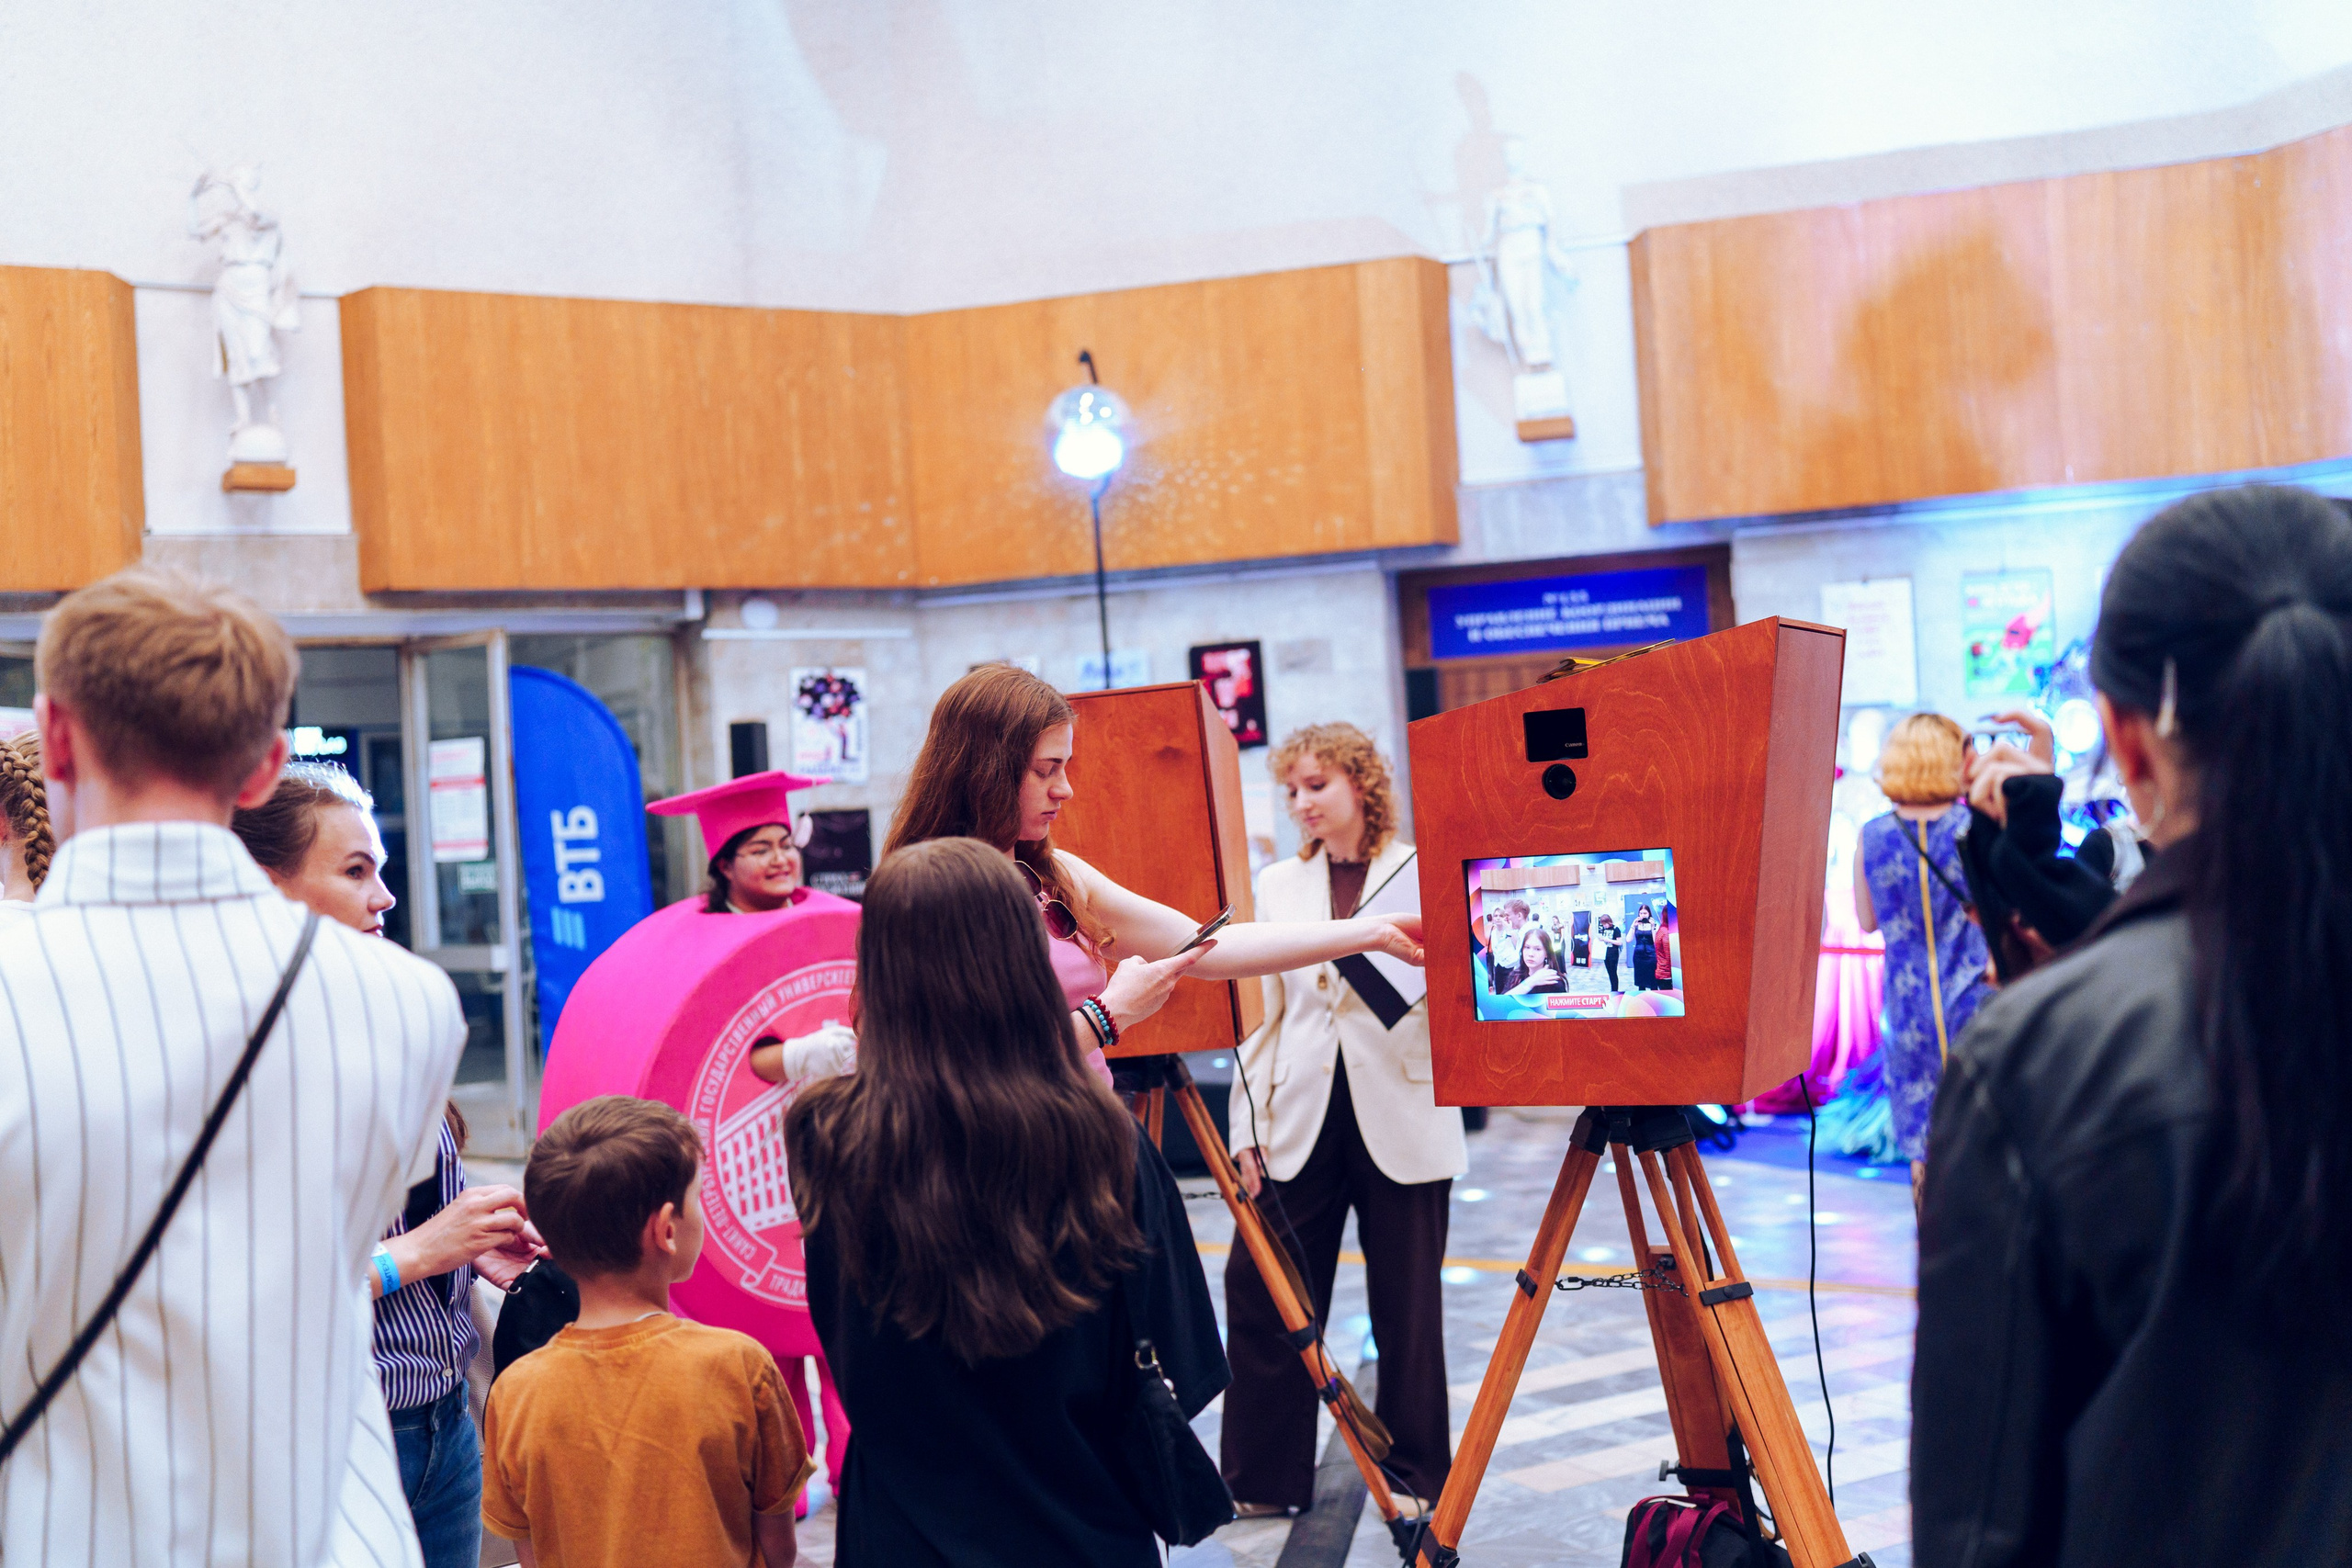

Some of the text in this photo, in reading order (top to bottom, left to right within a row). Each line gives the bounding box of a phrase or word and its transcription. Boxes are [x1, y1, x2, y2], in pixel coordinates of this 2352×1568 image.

[550, 805, 605, 904] ВТБ
[1550, 997, 1601, 1007] НАЖМИТЕ СТАРТ
[699, 992, 778, 1114] ГОСУДАРСТВЕННЫЙ
